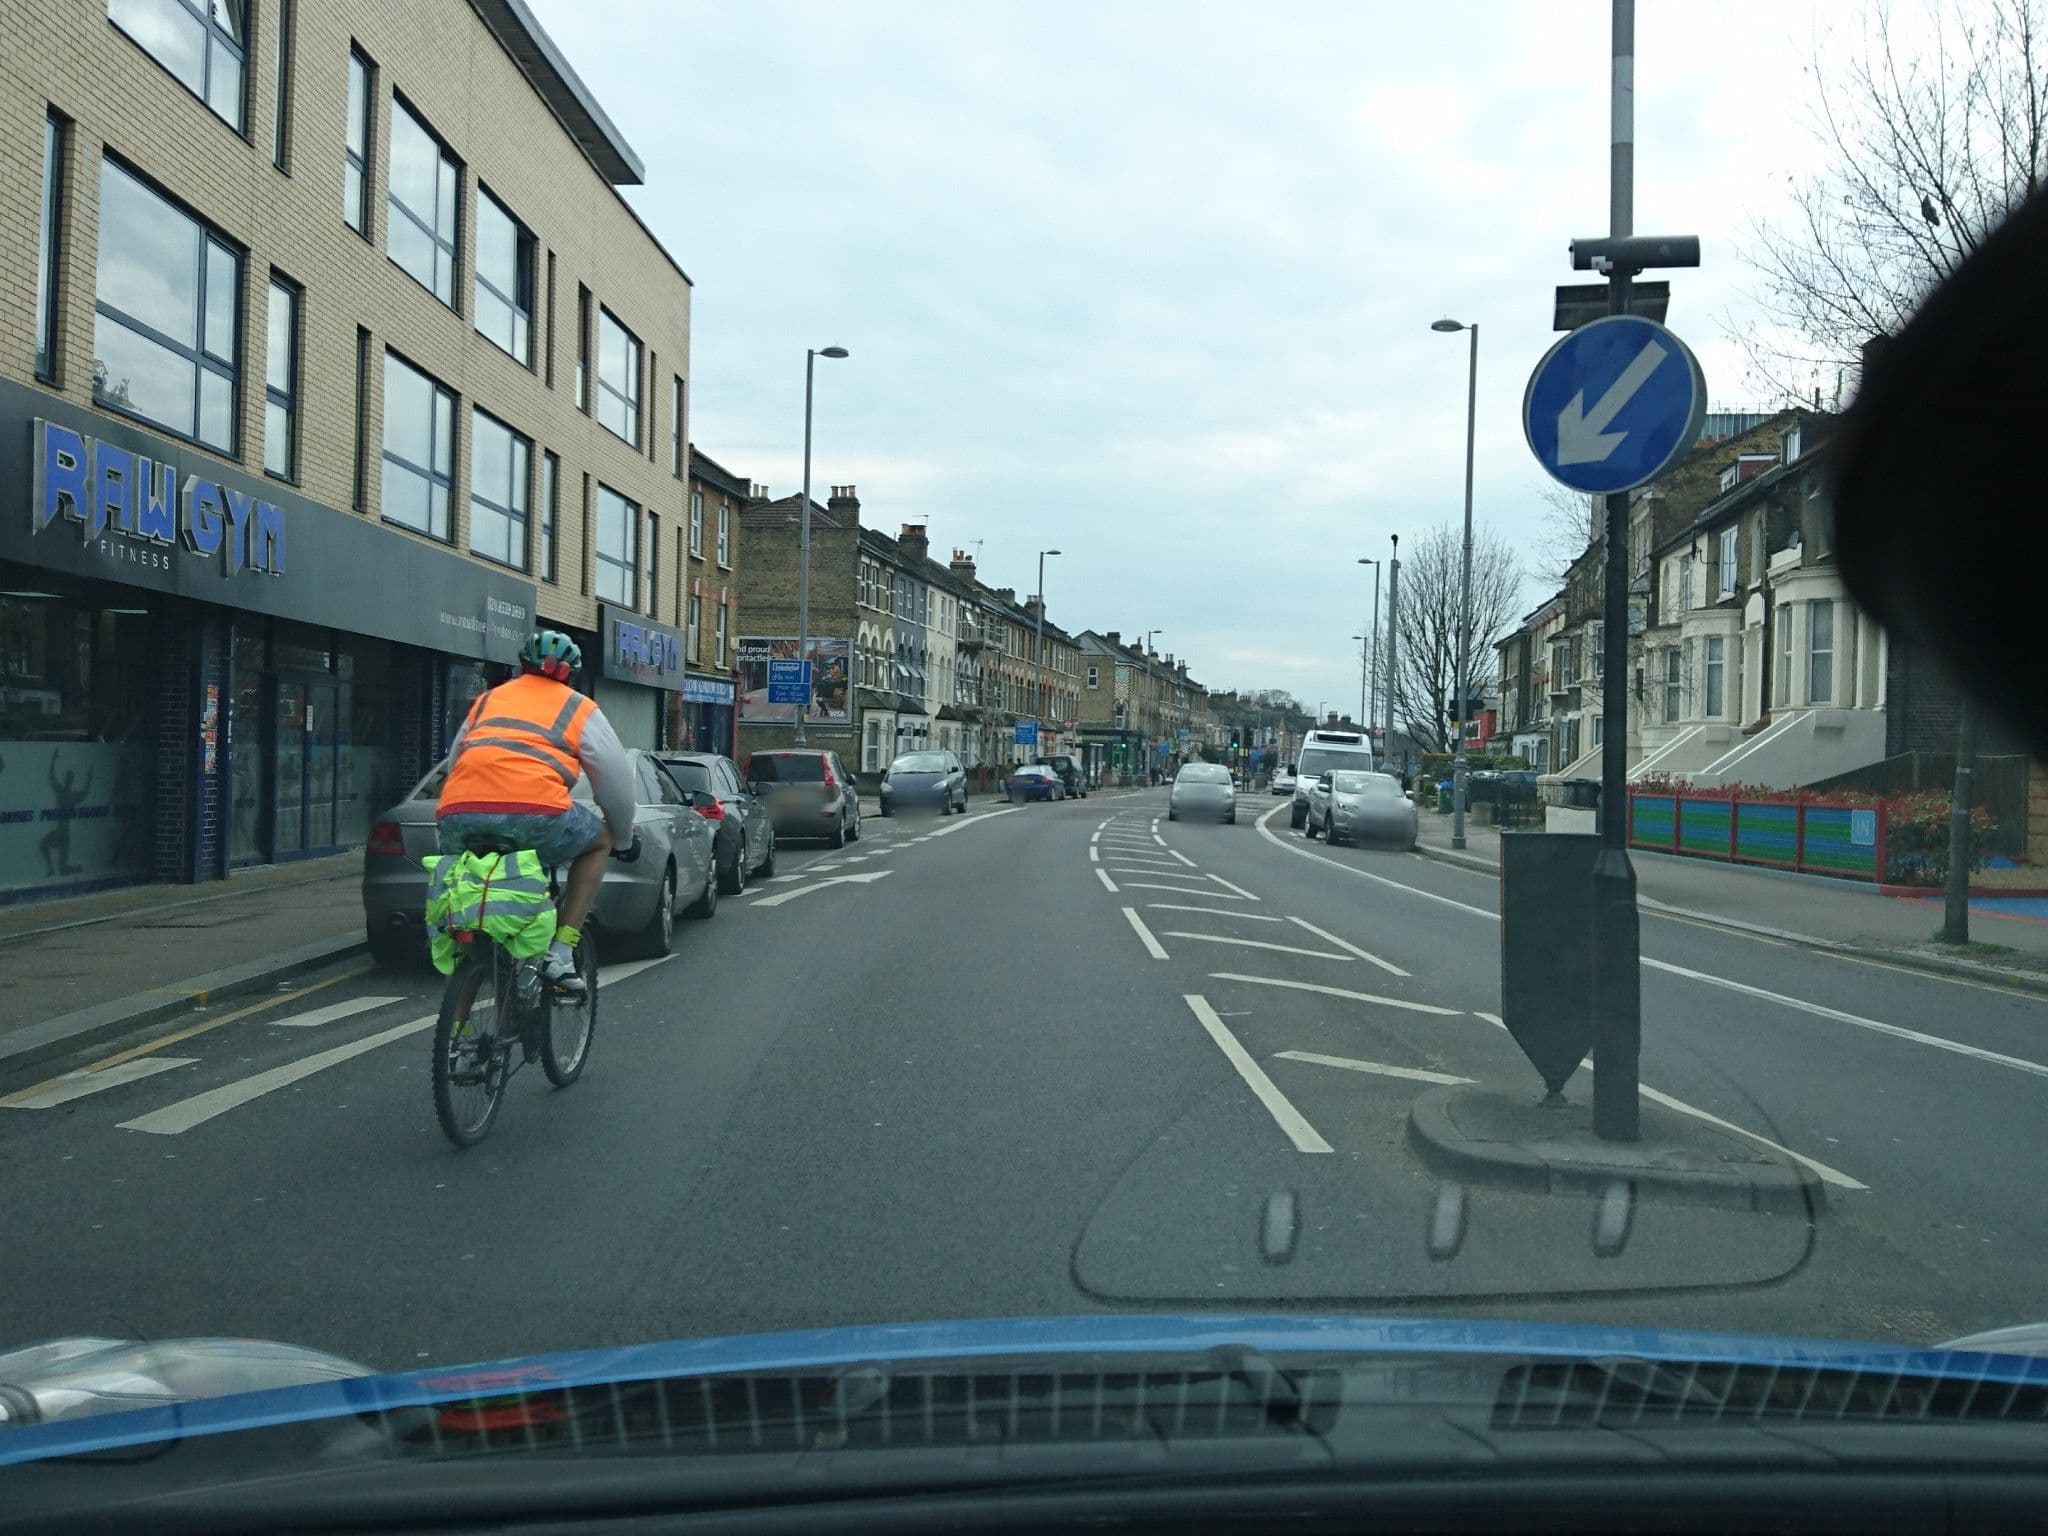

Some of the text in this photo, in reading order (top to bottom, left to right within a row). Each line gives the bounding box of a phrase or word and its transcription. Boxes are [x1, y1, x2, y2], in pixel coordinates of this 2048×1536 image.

[33, 416, 286, 582] RAW GYM
[99, 541, 170, 571] FITNESS
[737, 645, 770, 655] nd proud
[737, 654, 772, 662] ontactle
